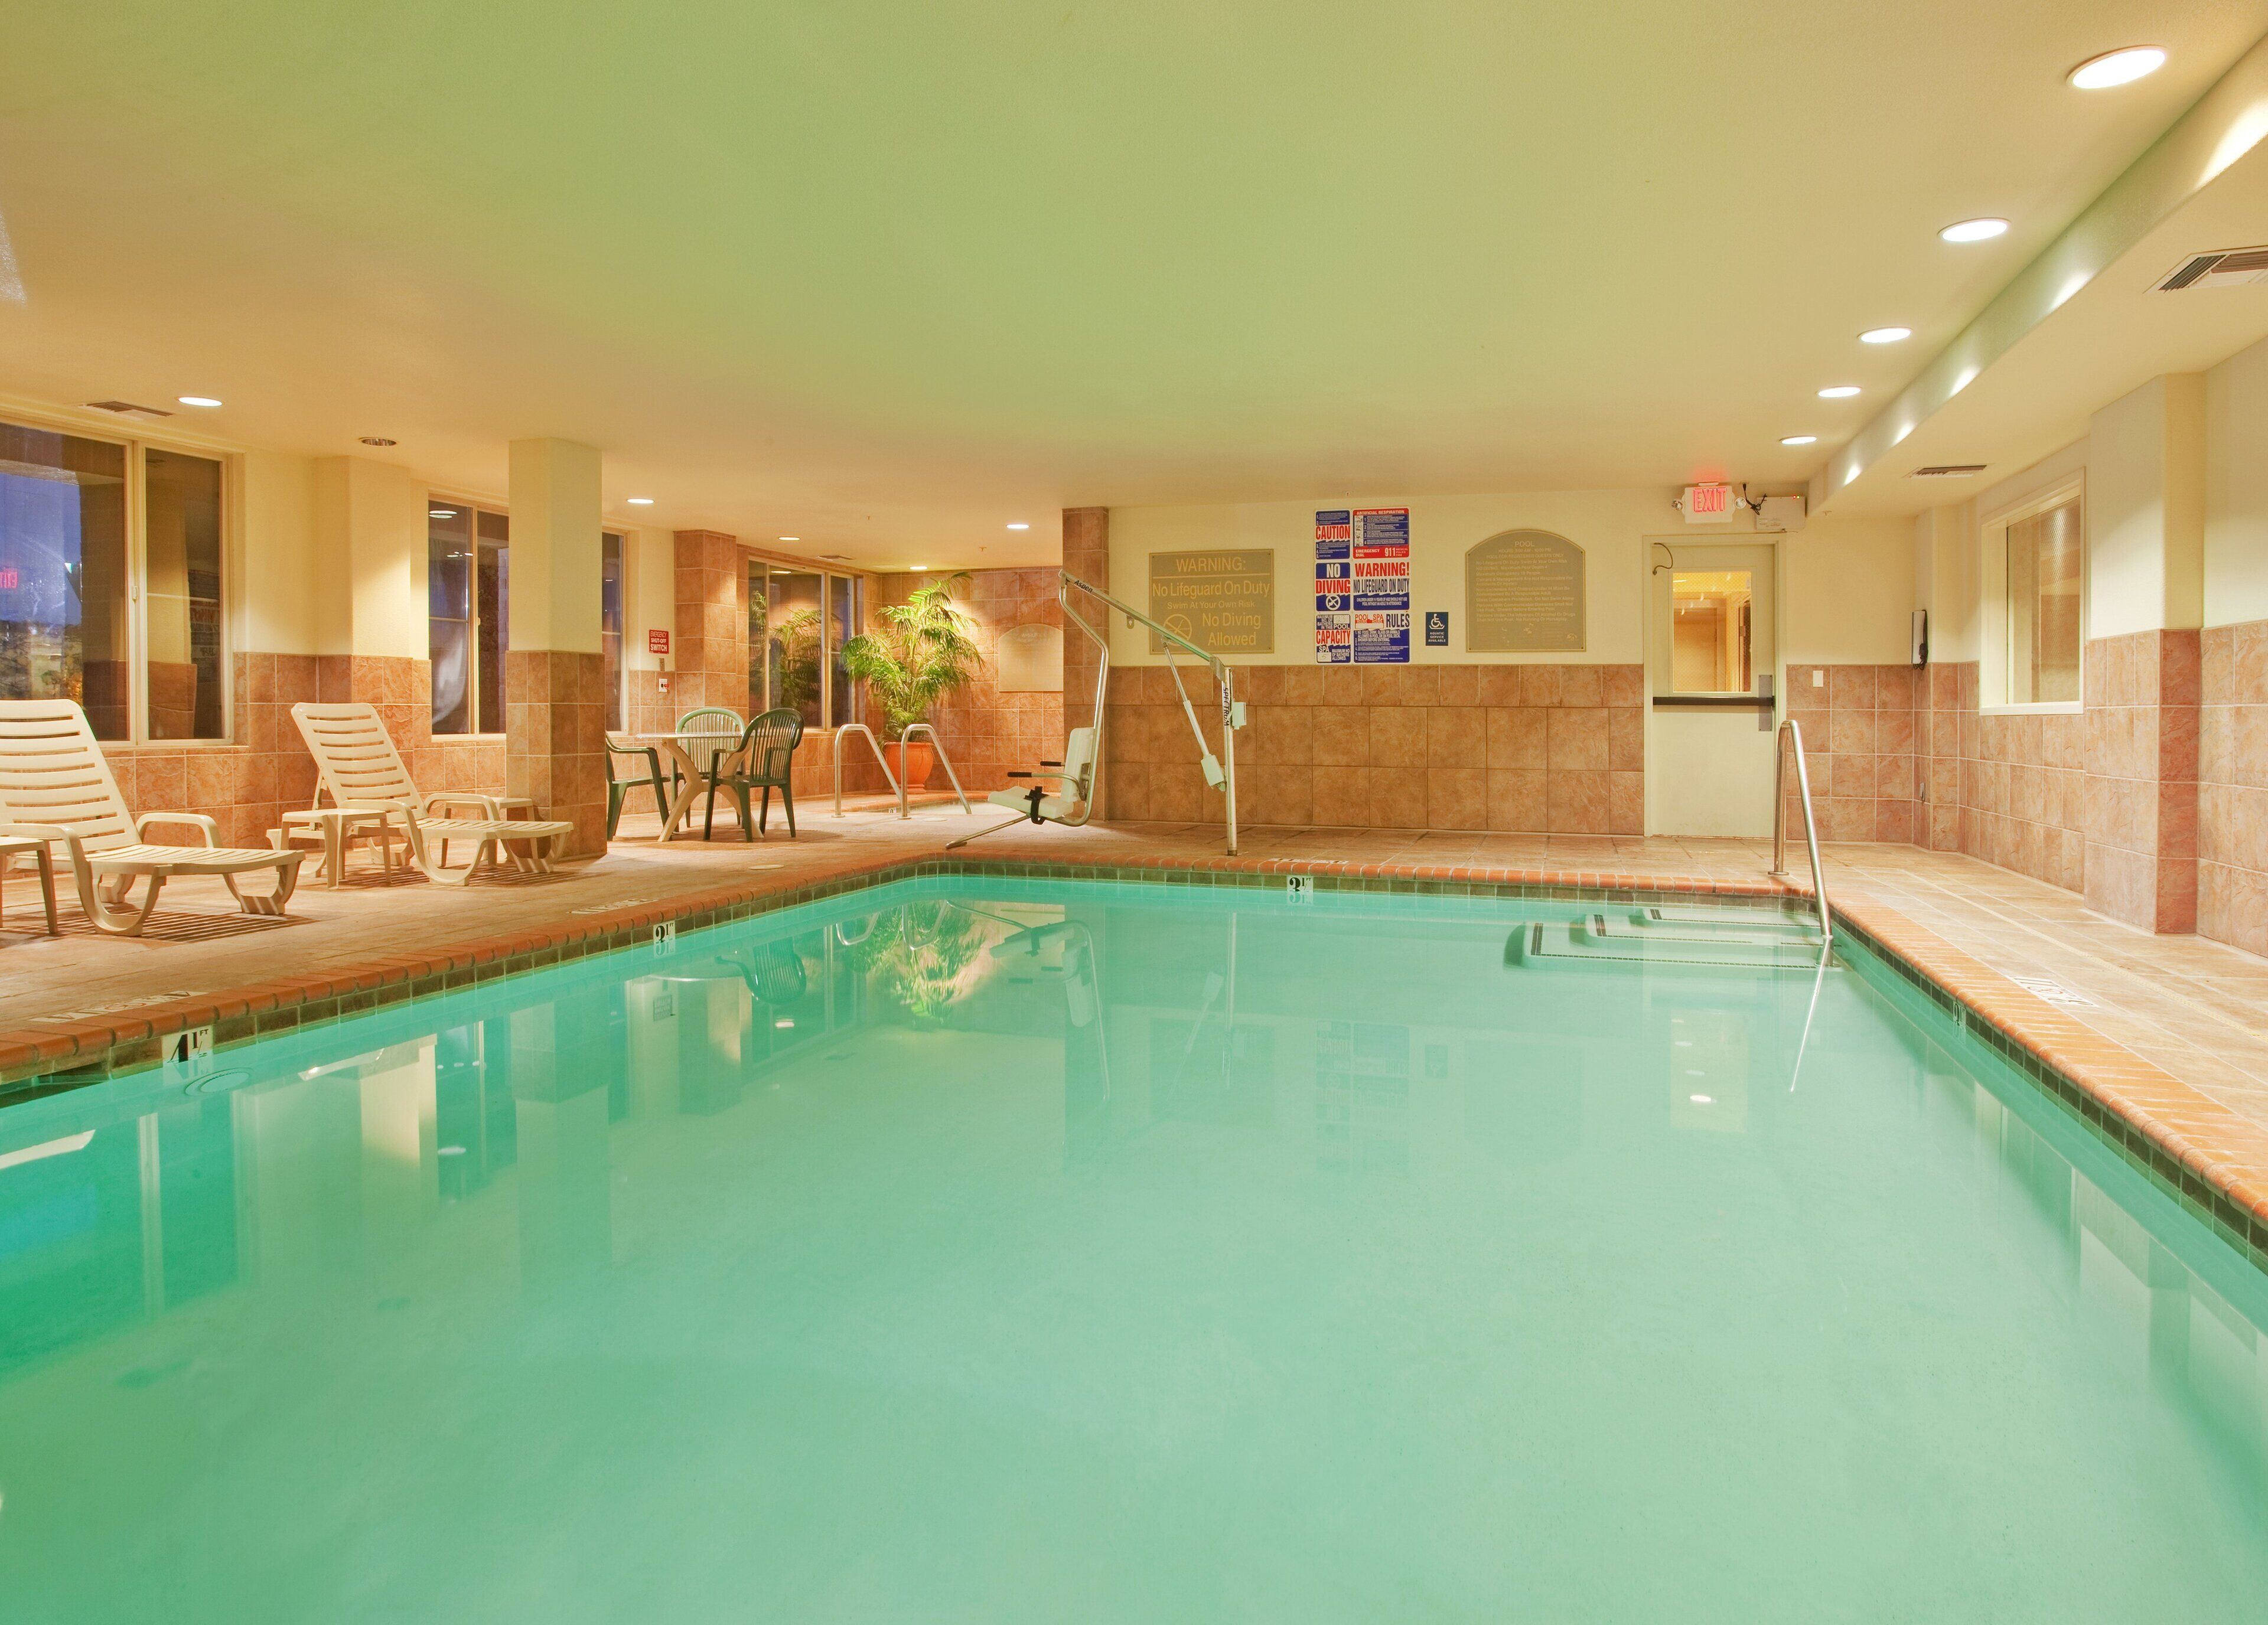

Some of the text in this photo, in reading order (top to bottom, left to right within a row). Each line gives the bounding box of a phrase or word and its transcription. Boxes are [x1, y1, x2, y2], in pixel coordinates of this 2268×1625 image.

[1693, 488, 1726, 512] EXIT
[1316, 526, 1350, 540] CAUTION
[1384, 547, 1396, 557] 911
[1177, 556, 1246, 572] WARNING:
[1327, 563, 1341, 577] NO
[1355, 562, 1409, 577] WARNING!
[1074, 580, 1093, 593] Aspen
[1153, 580, 1270, 599] No Lifeguard On Duty
[1316, 580, 1351, 593] DIVING
[1353, 578, 1410, 593] NO LIFEGUARD ON DUTY
[1167, 601, 1188, 610] Swim
[1190, 601, 1198, 609] At
[1203, 612, 1261, 629] No Diving
[1386, 614, 1410, 628] RULES
[1208, 632, 1256, 646] Allowed
[1317, 630, 1351, 644] CAPACITY
